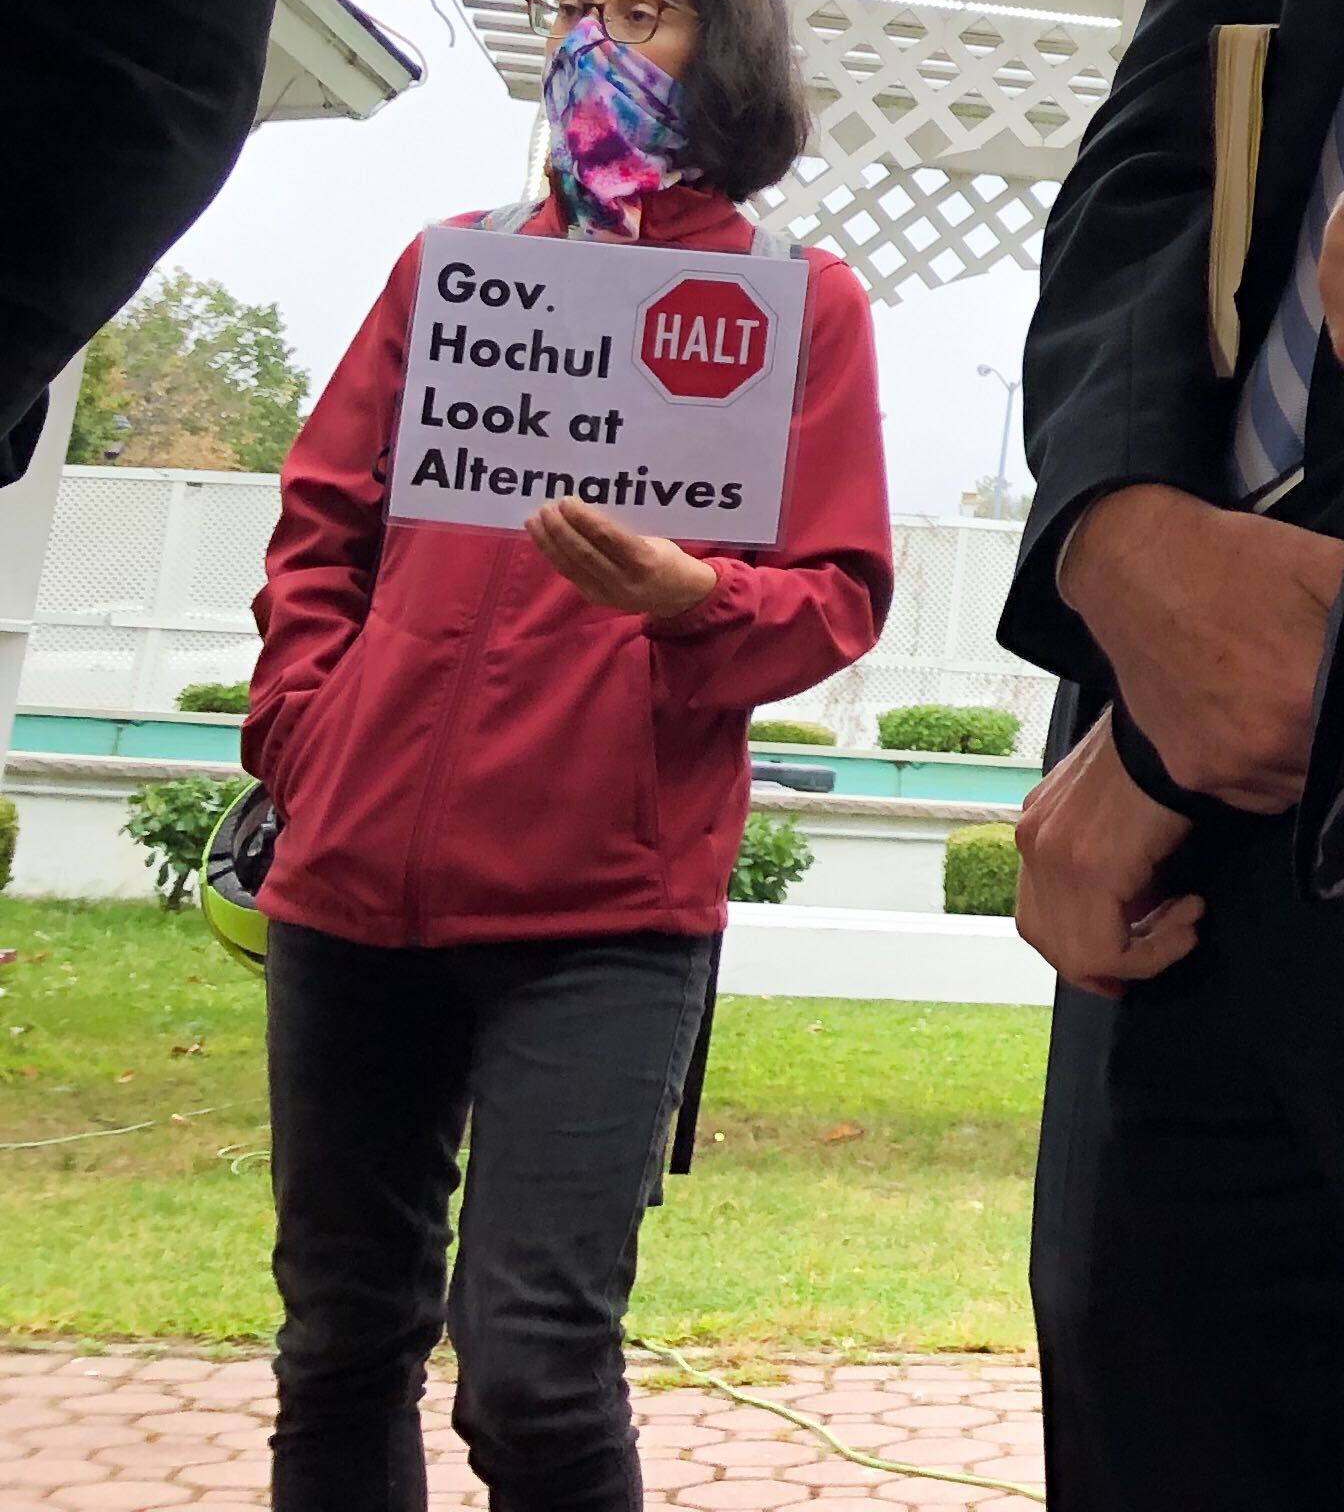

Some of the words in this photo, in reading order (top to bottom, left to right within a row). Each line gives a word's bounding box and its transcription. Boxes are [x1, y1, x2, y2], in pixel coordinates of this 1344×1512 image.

[437, 262, 555, 313] Gov.
[429, 322, 612, 378] Hochul
[654, 312, 760, 366] HALT
[420, 386, 551, 438] Look
[569, 408, 623, 444] at
[411, 448, 743, 510] Alternatives
